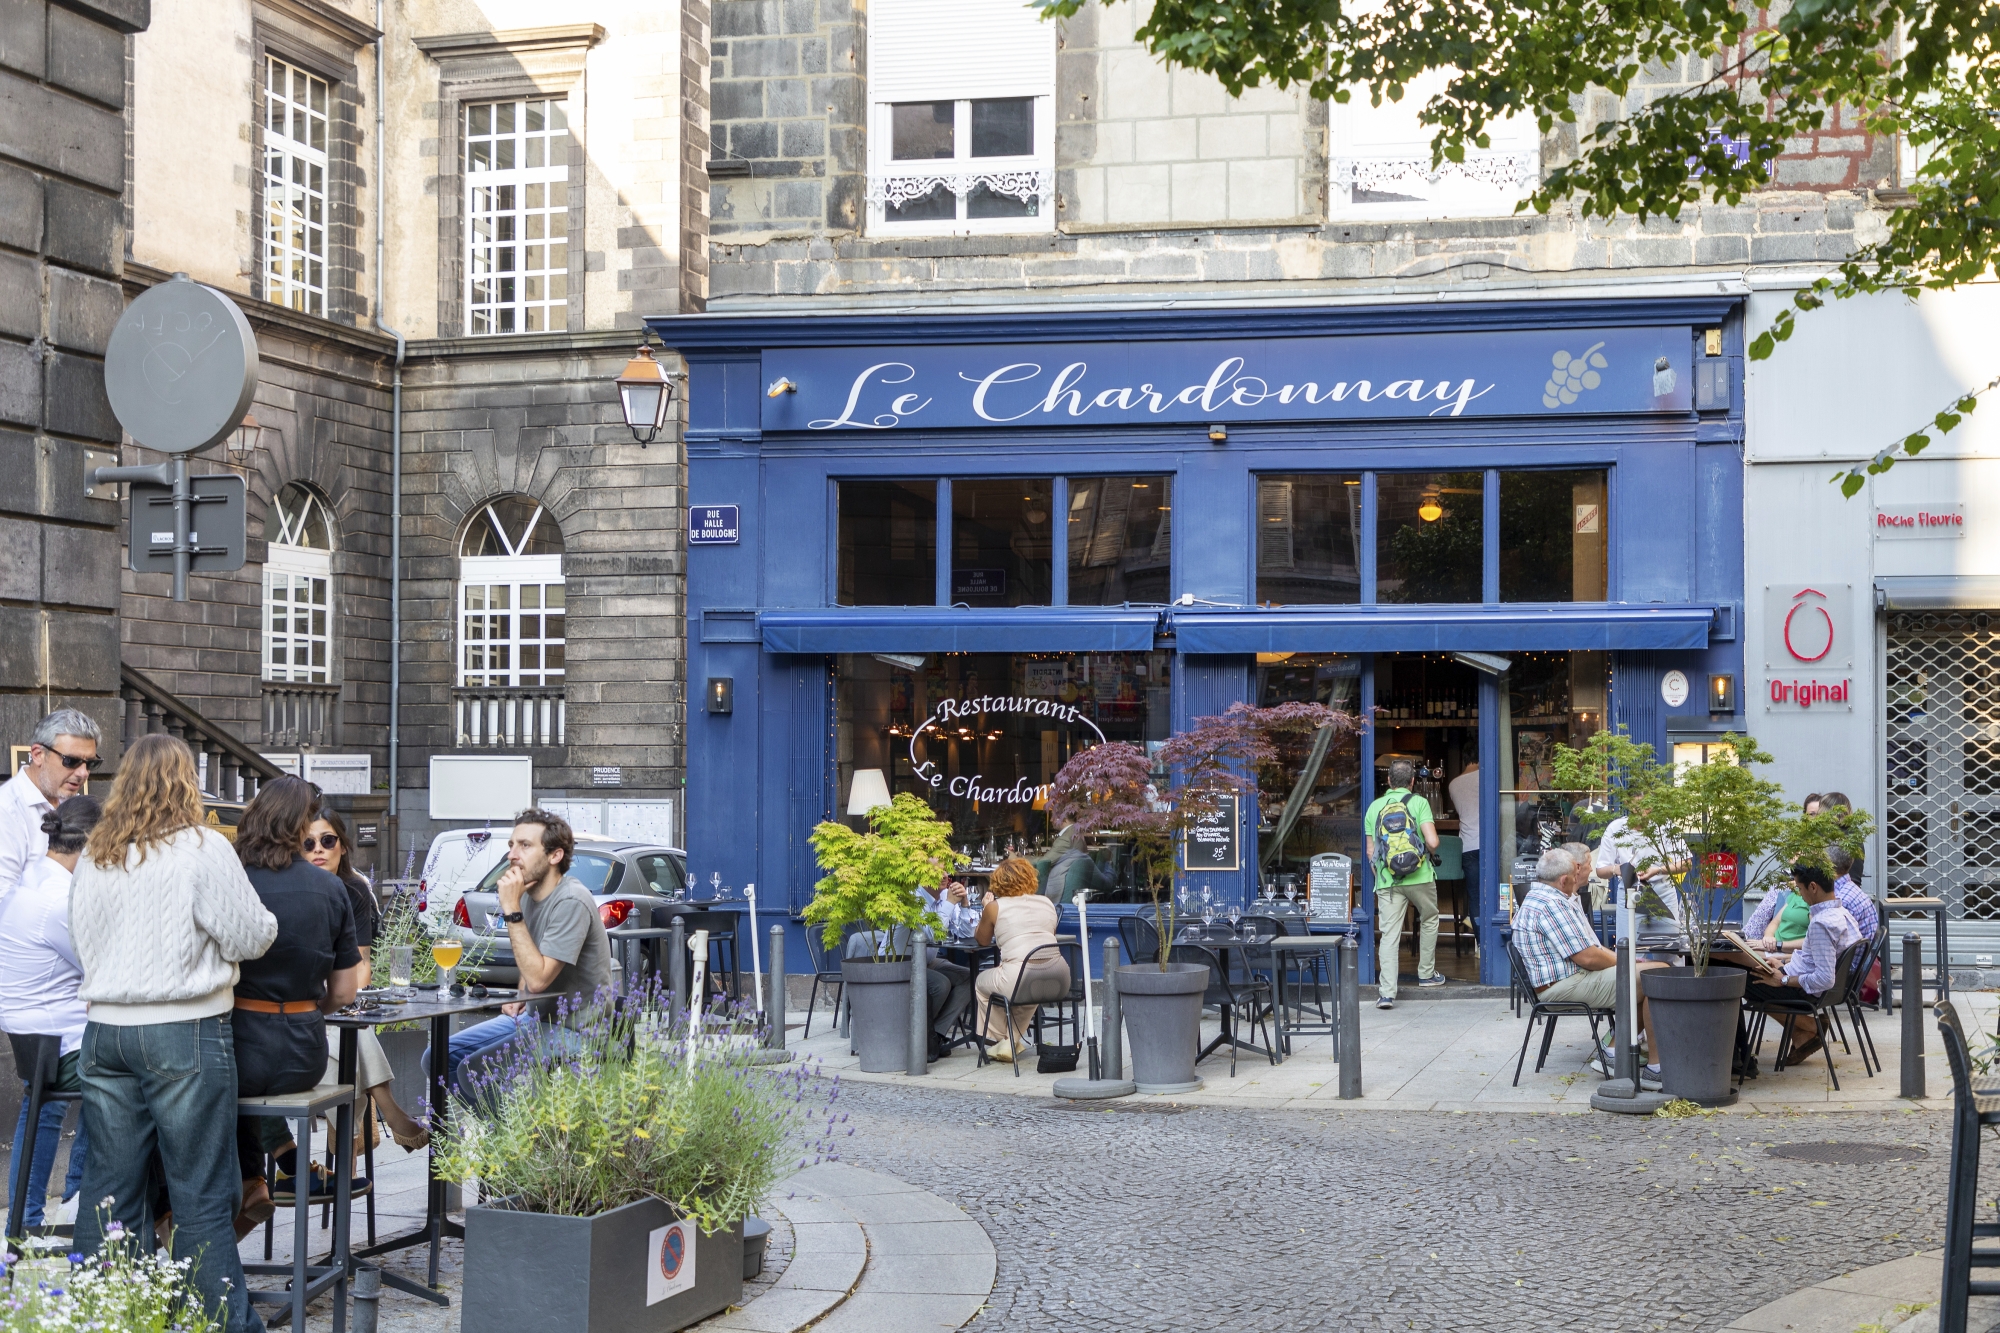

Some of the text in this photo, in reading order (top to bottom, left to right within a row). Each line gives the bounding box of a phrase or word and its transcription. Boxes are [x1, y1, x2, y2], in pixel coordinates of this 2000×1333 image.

[808, 356, 1495, 429] Le Chardonnay
[704, 519, 723, 527] HALLE
[707, 510, 720, 518] RUE
[1877, 512, 1963, 527] Roche Fleurie
[691, 529, 736, 538] DE BOULOGNE
[1770, 679, 1848, 707] Original
[937, 694, 1079, 722] Restaurant
[913, 761, 1068, 804] Le Chardon
